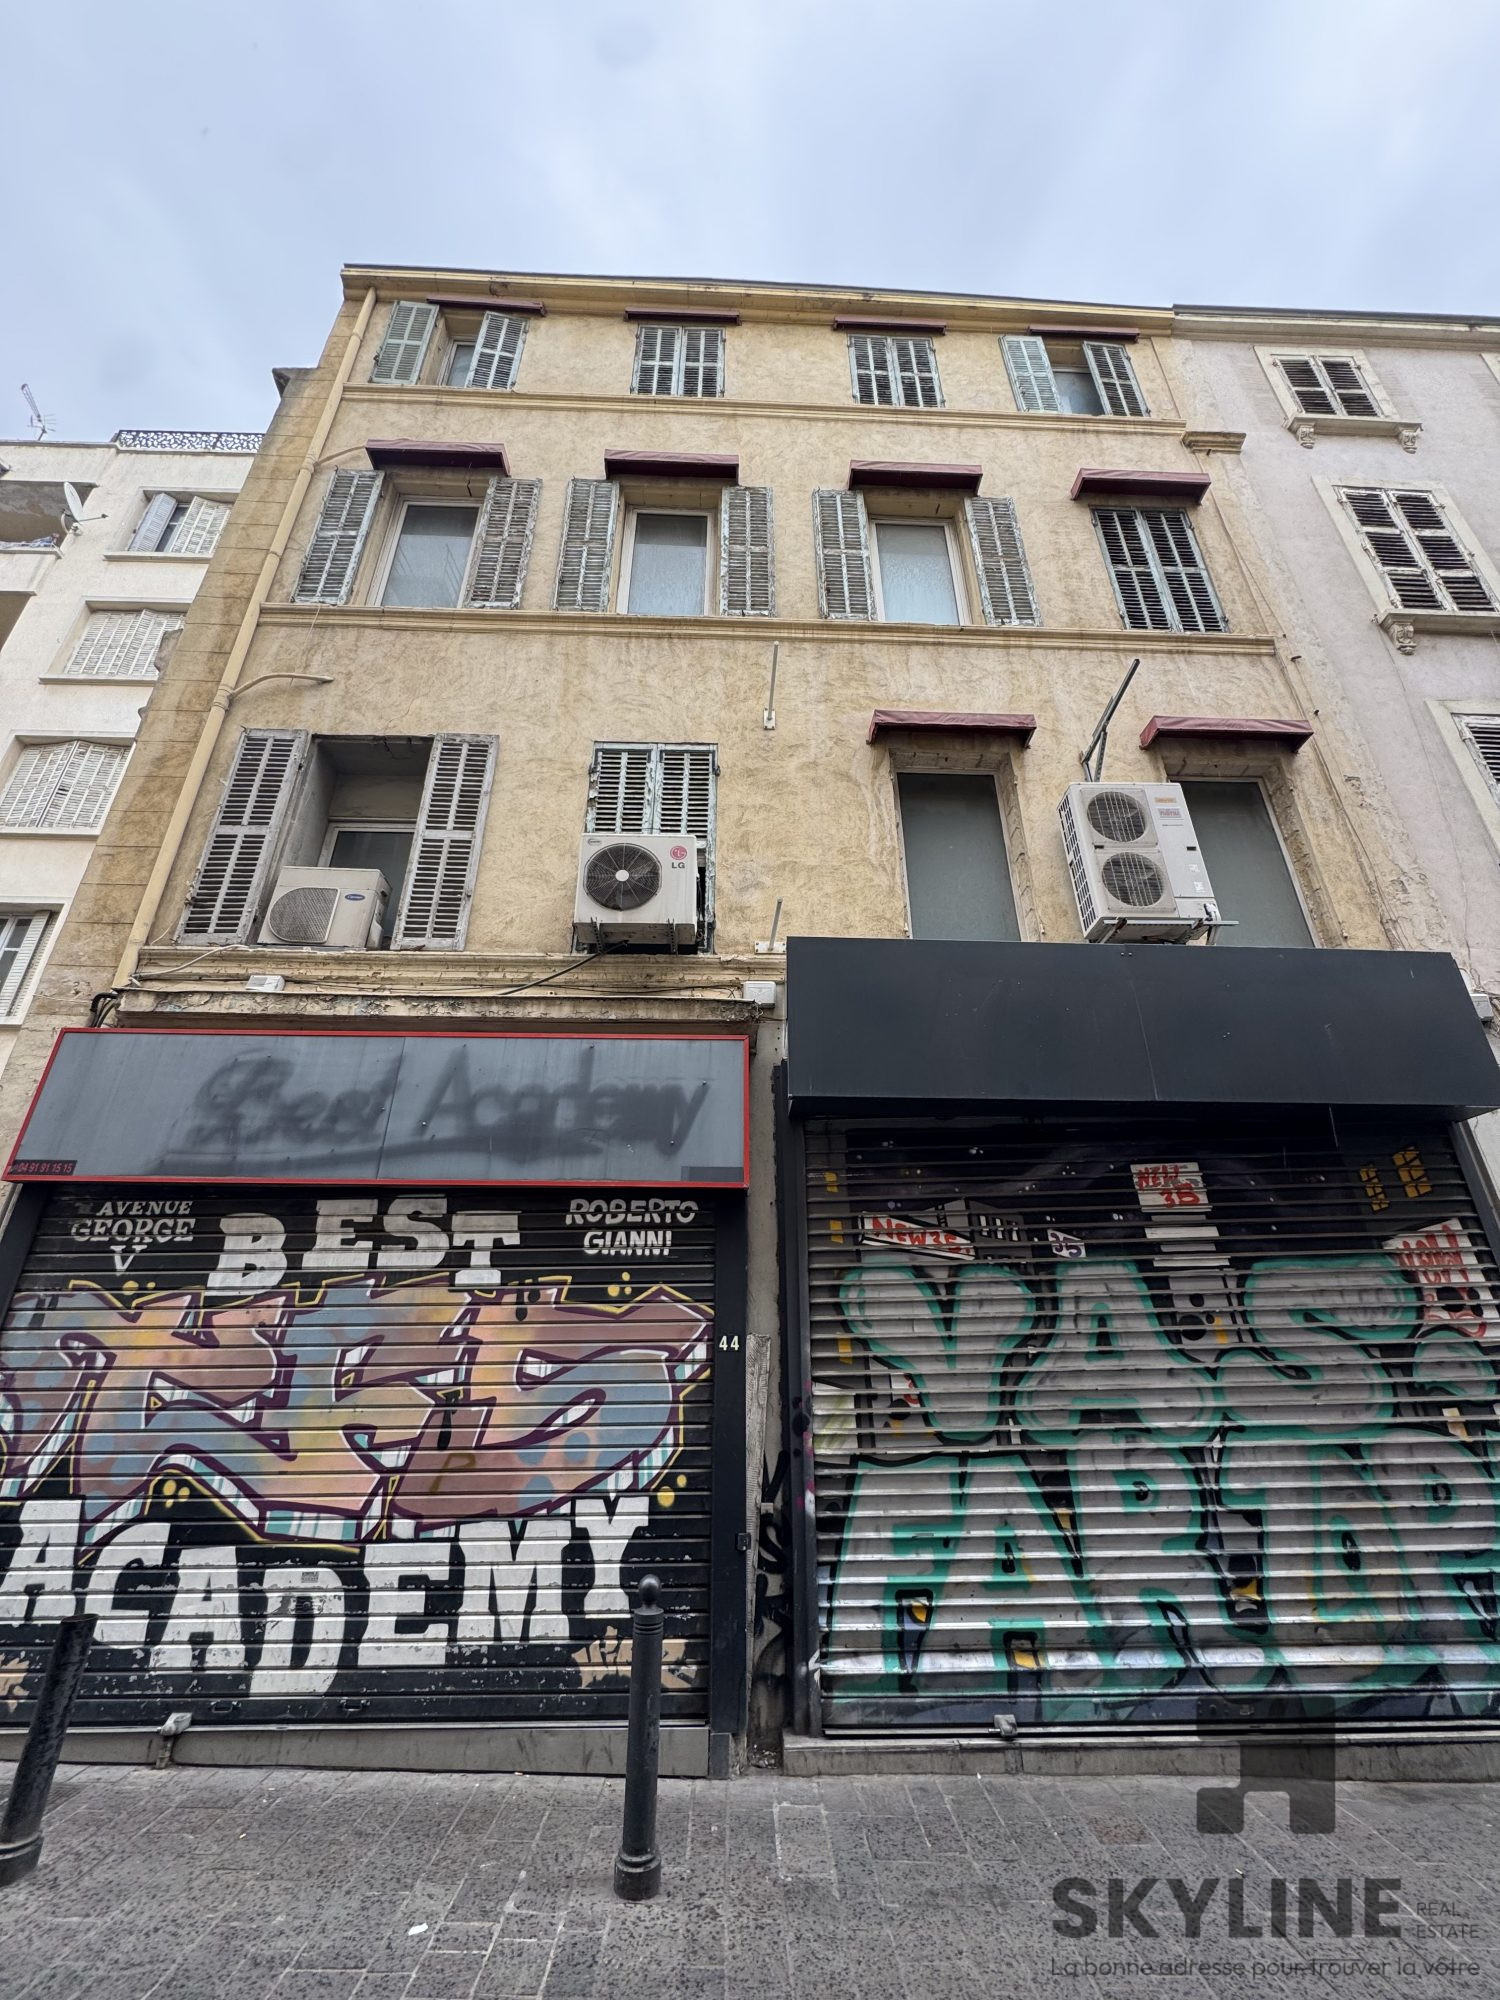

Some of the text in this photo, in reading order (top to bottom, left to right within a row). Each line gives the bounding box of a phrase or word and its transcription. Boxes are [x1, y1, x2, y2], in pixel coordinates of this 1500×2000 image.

[29, 1162, 39, 1172] 91
[40, 1162, 50, 1172] 91
[52, 1162, 62, 1173] 15
[63, 1163, 73, 1173] 15
[96, 1200, 193, 1216] AVENUE
[565, 1198, 699, 1225] ROBERTO
[71, 1218, 196, 1243] GEORGE
[583, 1230, 672, 1256] GIANNI
[203, 1194, 521, 1297] BEST
[109, 1244, 148, 1276] V
[718, 1335, 740, 1352] 44
[0, 1495, 649, 1701] ACADEMY
